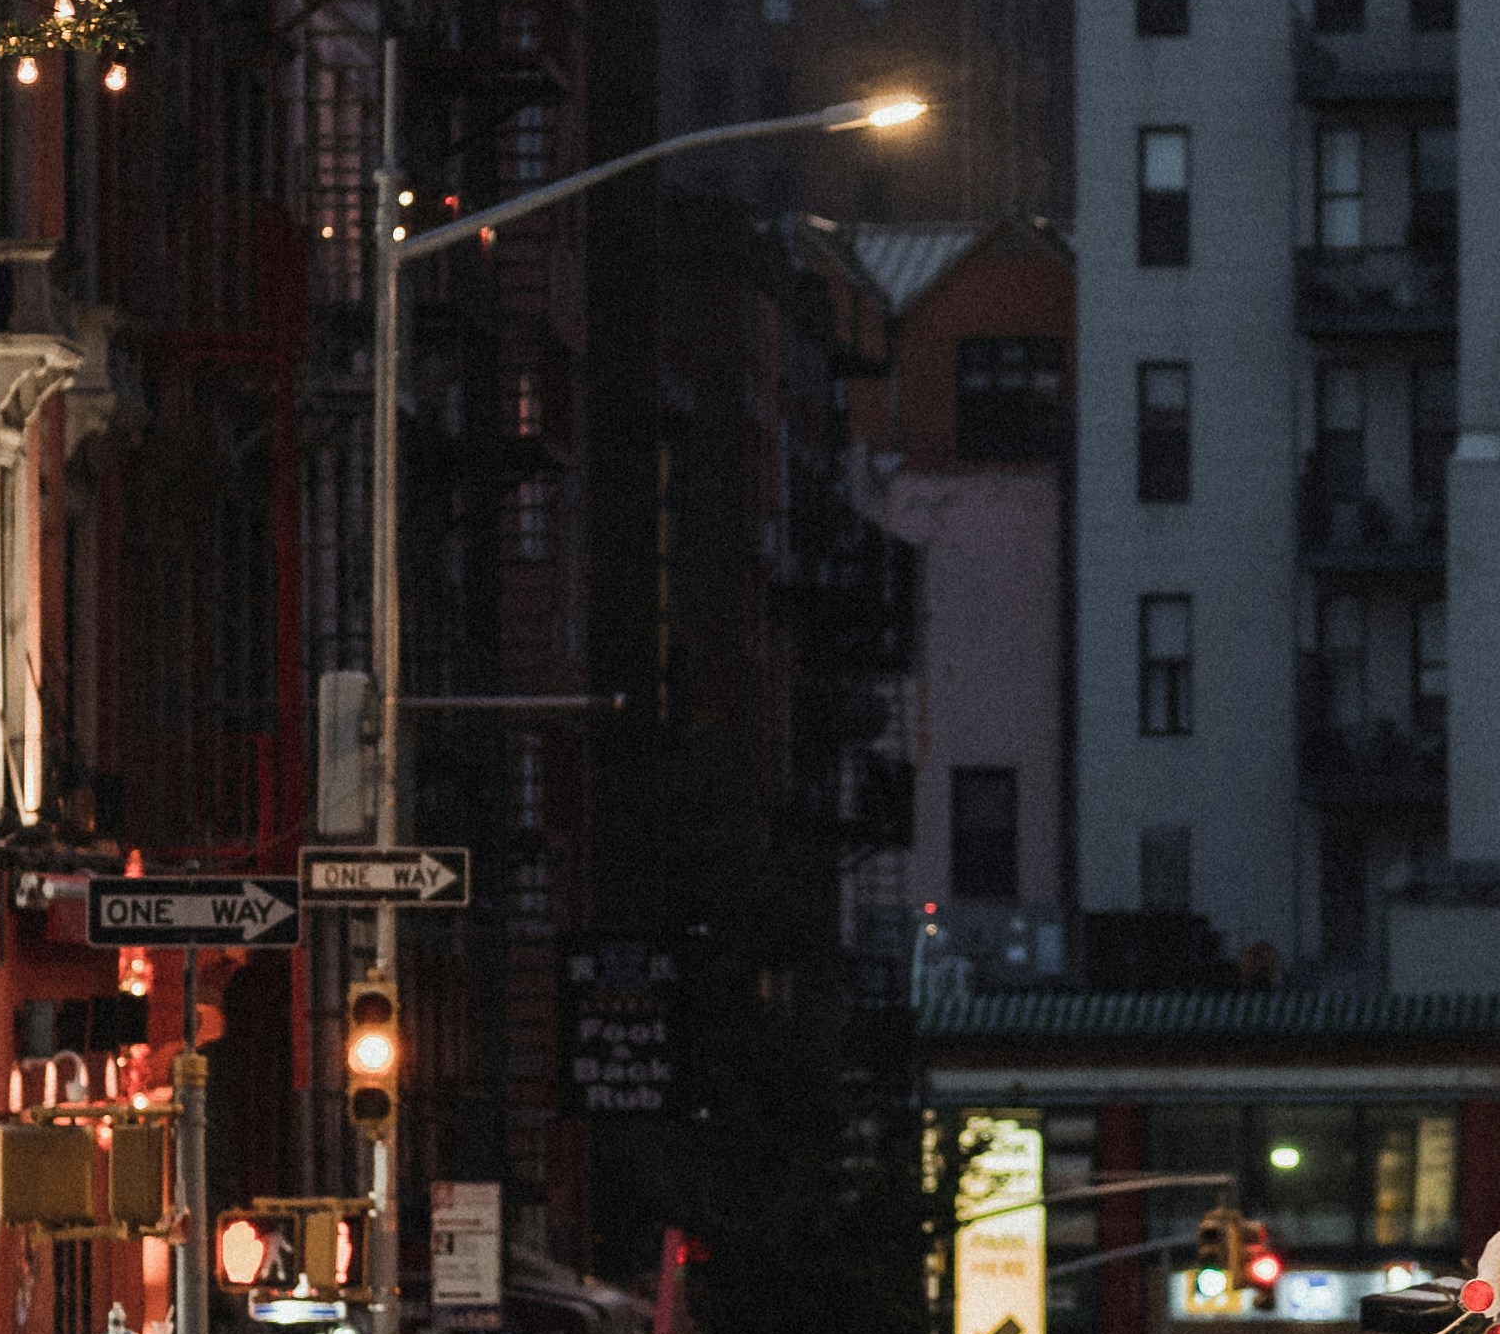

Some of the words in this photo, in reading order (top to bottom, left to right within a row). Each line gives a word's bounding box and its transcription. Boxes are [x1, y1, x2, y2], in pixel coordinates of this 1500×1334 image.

[323, 867, 372, 889] ONE
[394, 867, 442, 889] WAY
[105, 898, 174, 927] ONE
[211, 897, 273, 925] WAY
[579, 1017, 667, 1044] Foot
[572, 1056, 673, 1082] Back
[586, 1084, 663, 1110] Rub
